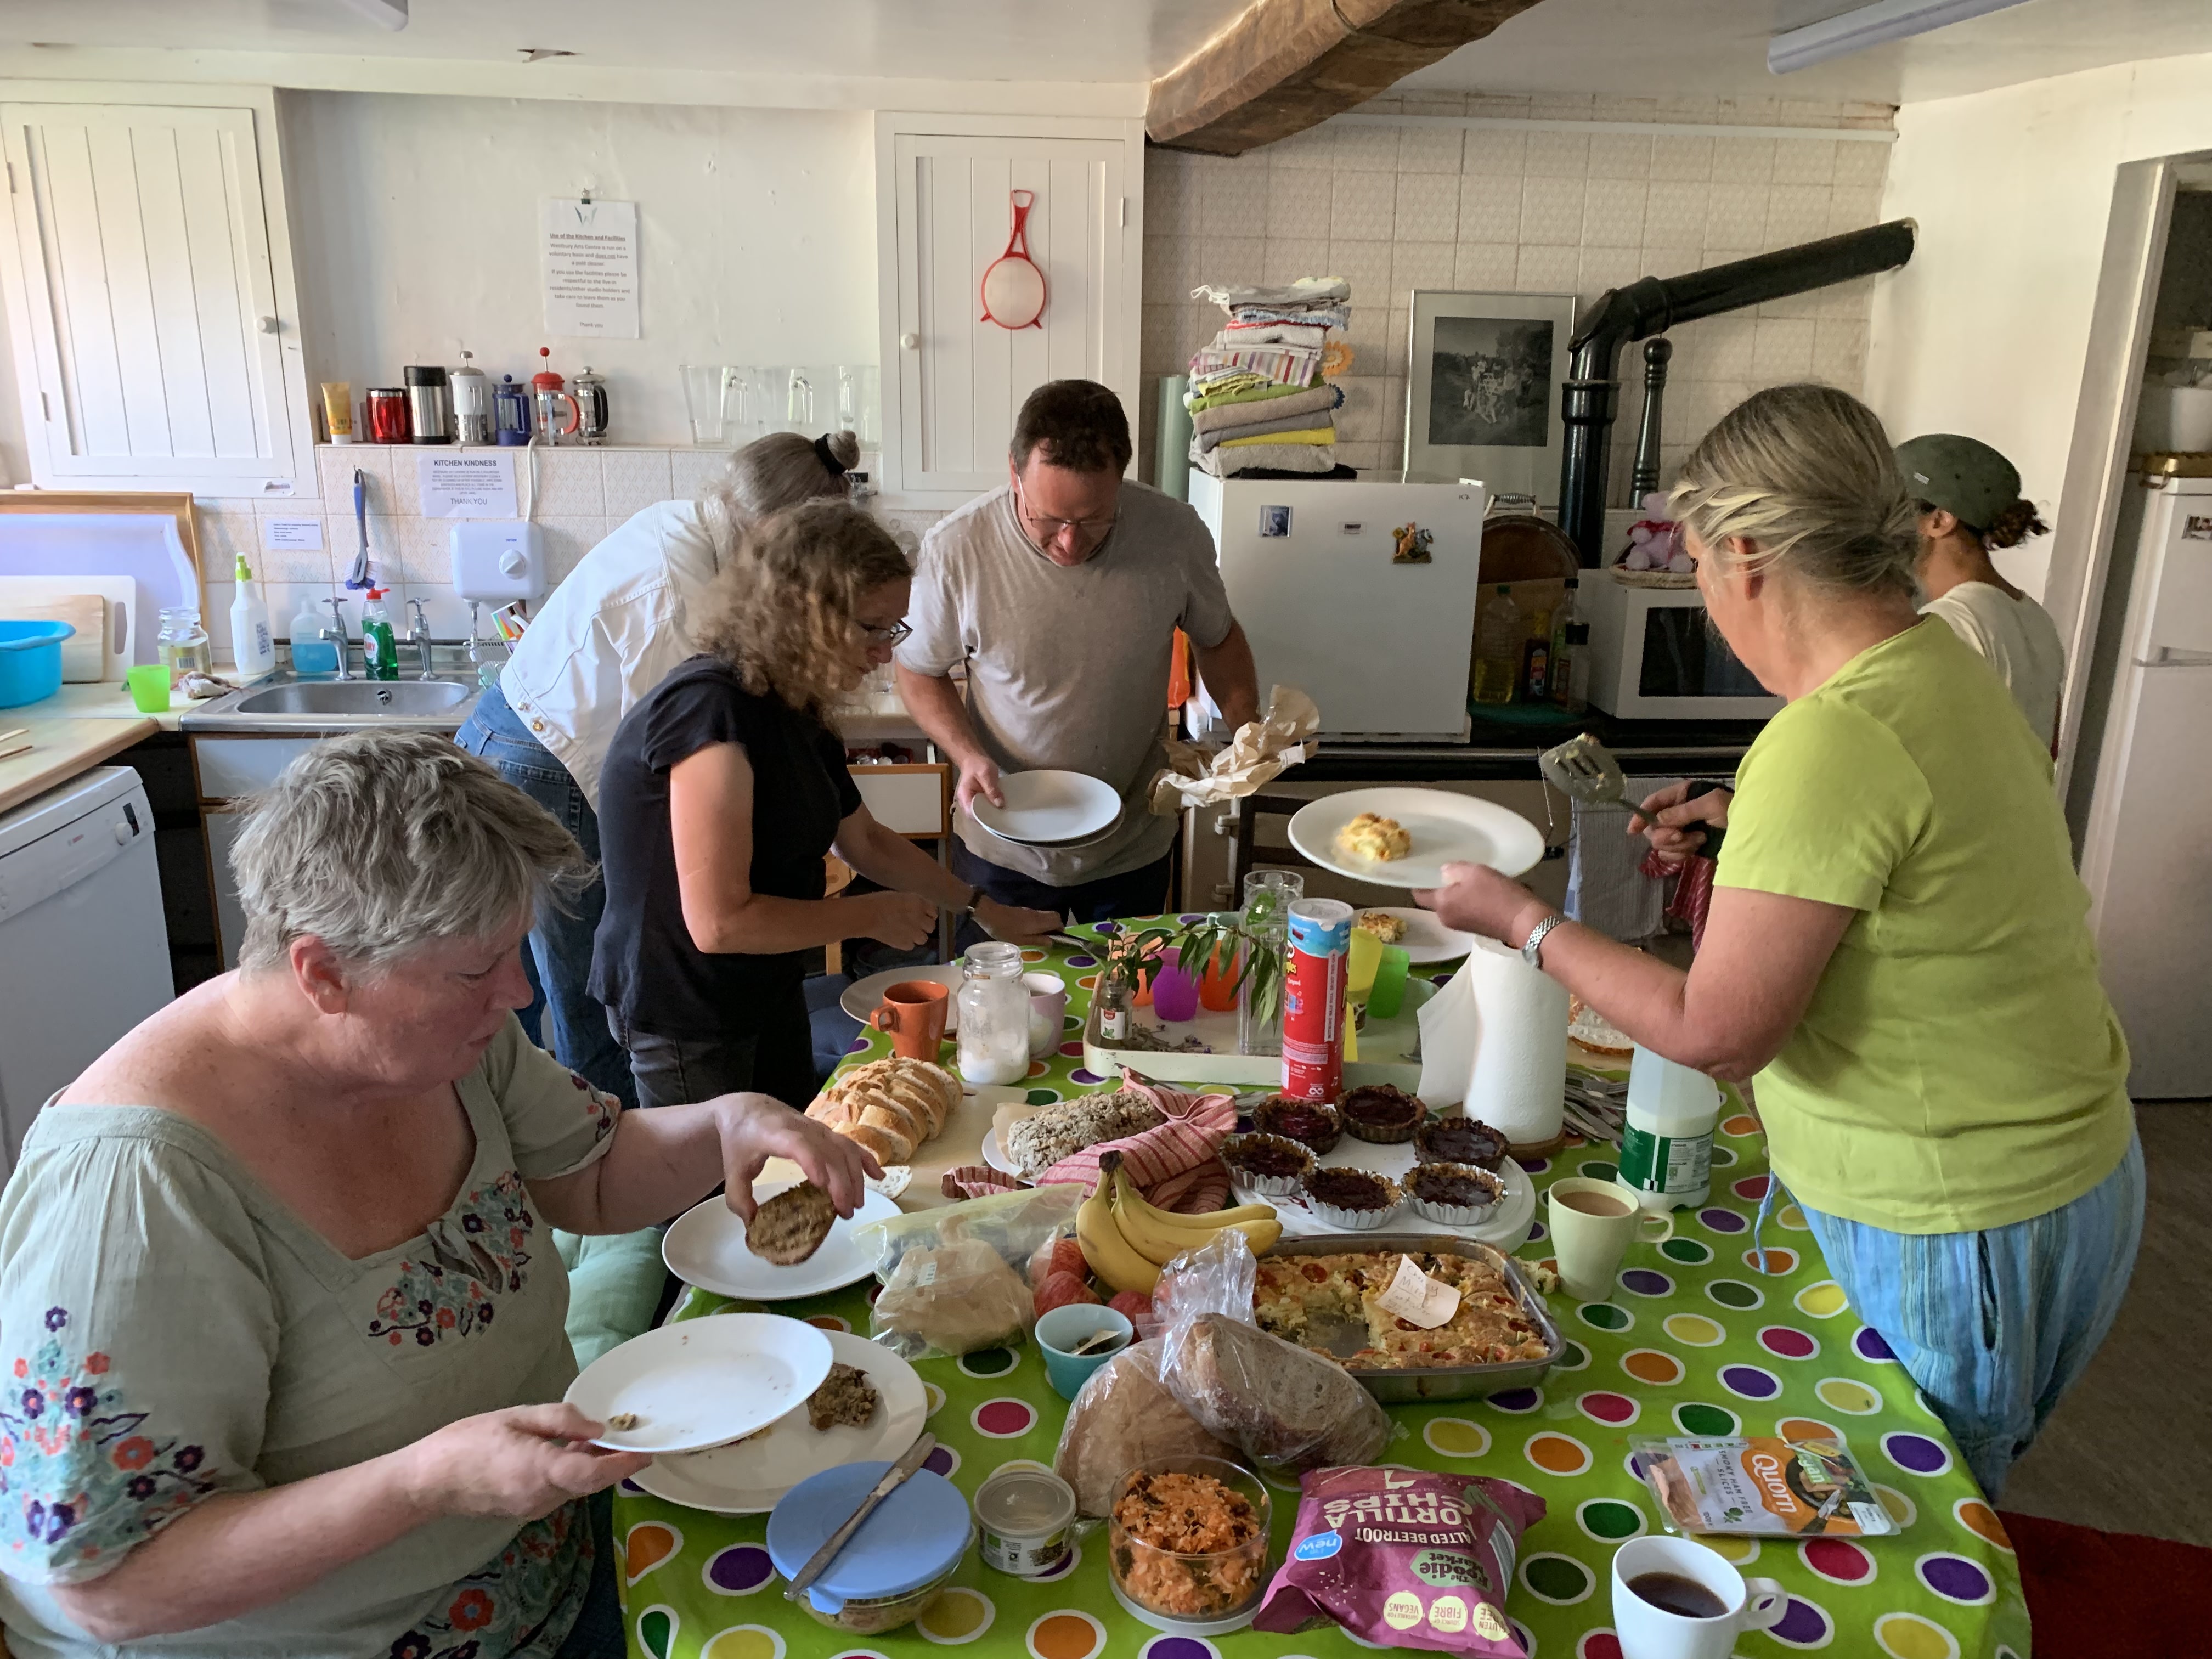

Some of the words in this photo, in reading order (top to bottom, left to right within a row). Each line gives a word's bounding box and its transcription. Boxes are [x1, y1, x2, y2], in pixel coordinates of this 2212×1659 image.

[1798, 1453, 1825, 1483] egan
[1717, 1468, 1734, 1495] SLICES
[1719, 1450, 1735, 1476] SMOKY
[1730, 1479, 1743, 1494] HAM
[1738, 1497, 1753, 1514] FREE
[1752, 1454, 1797, 1513] Quorn
[1323, 1492, 1473, 1515] CHIPS
[1324, 1507, 1471, 1533] ORTILLA
[1299, 1538, 1337, 1553] new
[1354, 1527, 1429, 1543] BEETROOT
[1431, 1532, 1472, 1544] ALTED
[1429, 1553, 1483, 1572] Market
[1419, 1562, 1488, 1588] Foodie
[1450, 1575, 1470, 1583] The
[1389, 1602, 1419, 1614] VEGANS
[1434, 1606, 1462, 1619] FIBRE
